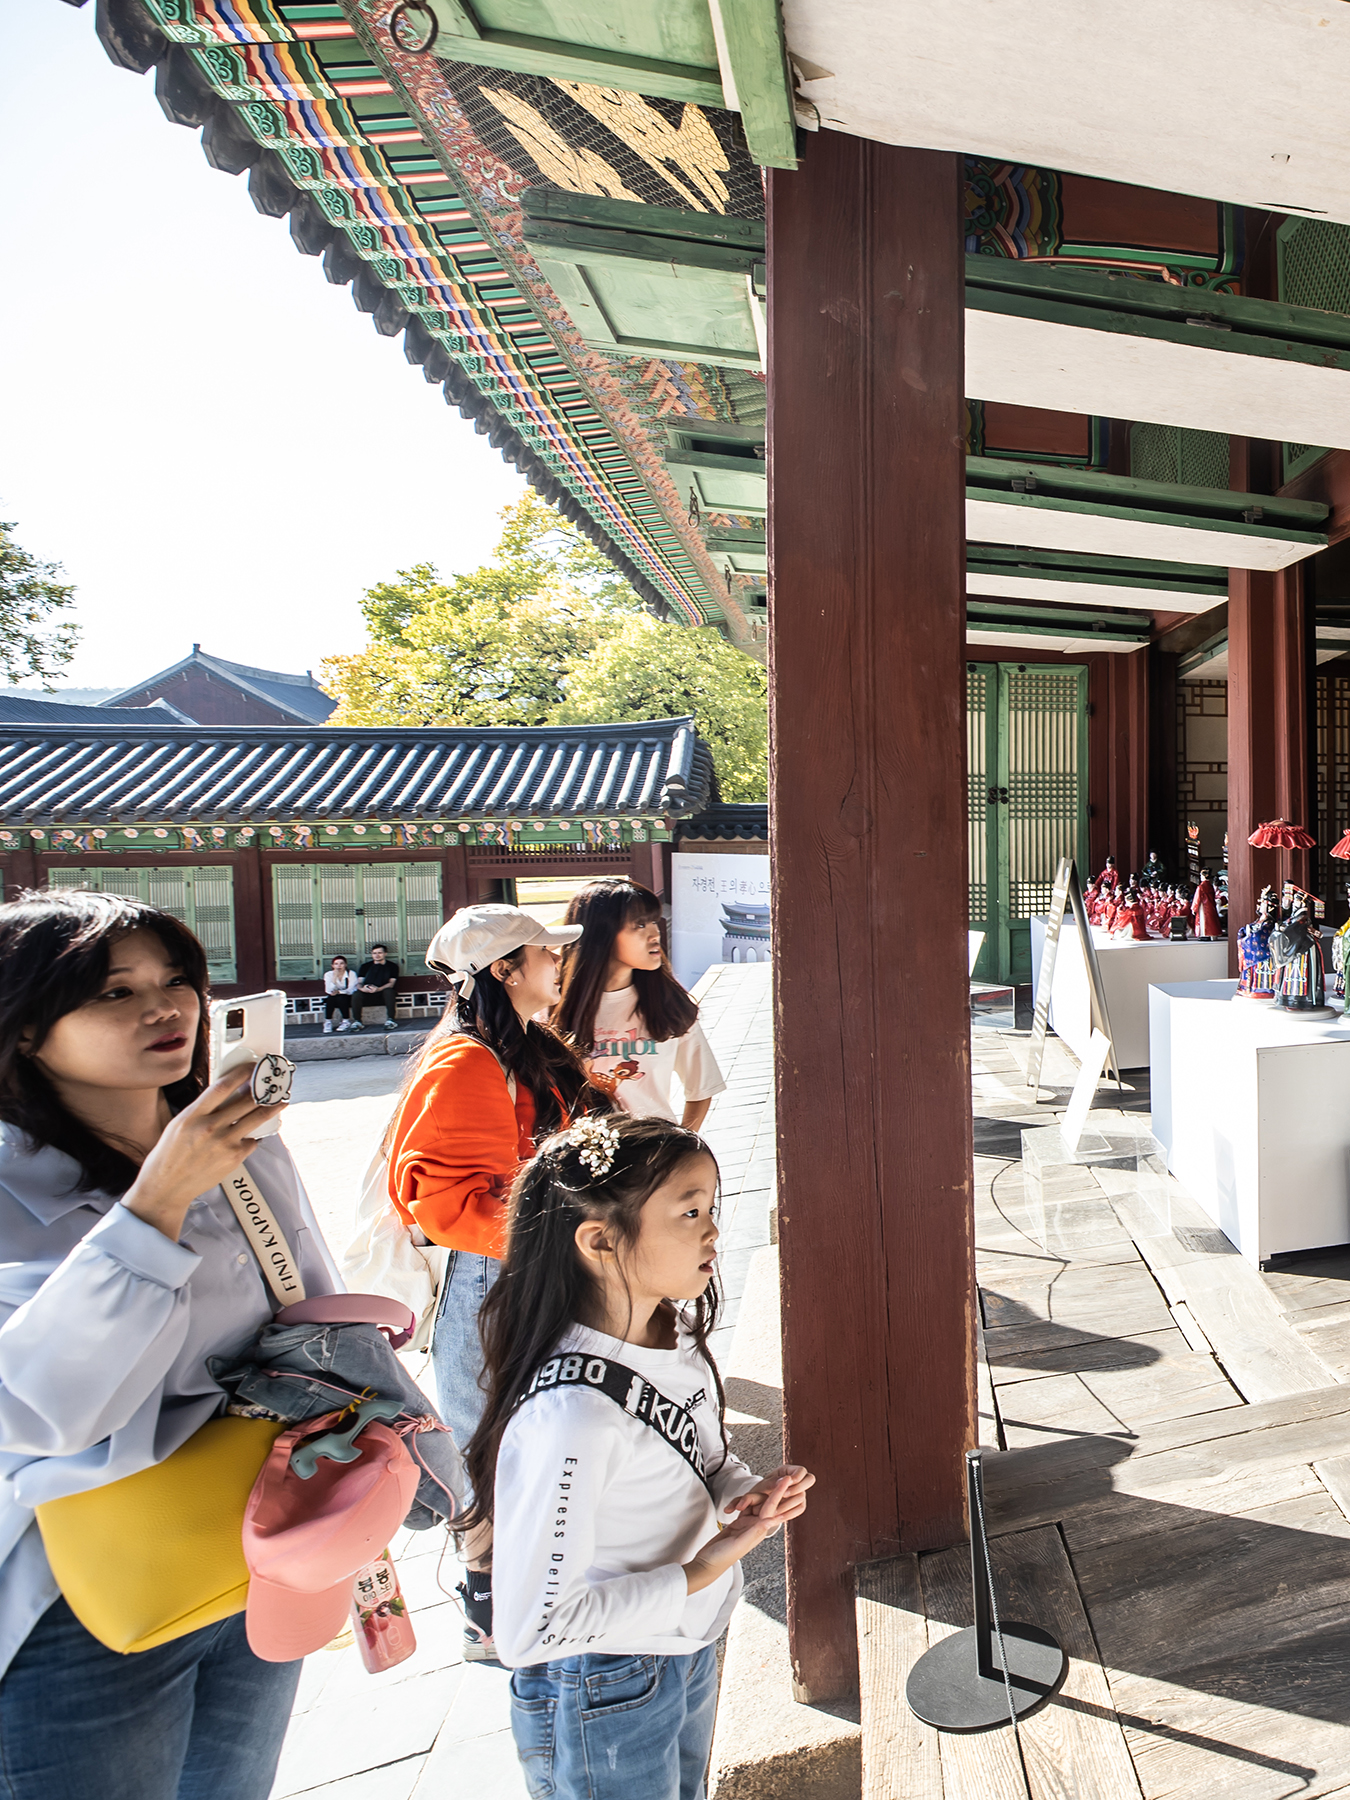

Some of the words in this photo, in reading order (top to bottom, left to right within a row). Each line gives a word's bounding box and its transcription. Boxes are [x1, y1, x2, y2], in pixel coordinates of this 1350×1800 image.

[232, 1176, 278, 1248] KAPOOR
[270, 1251, 297, 1292] FIND
[554, 1457, 578, 1539] Express
